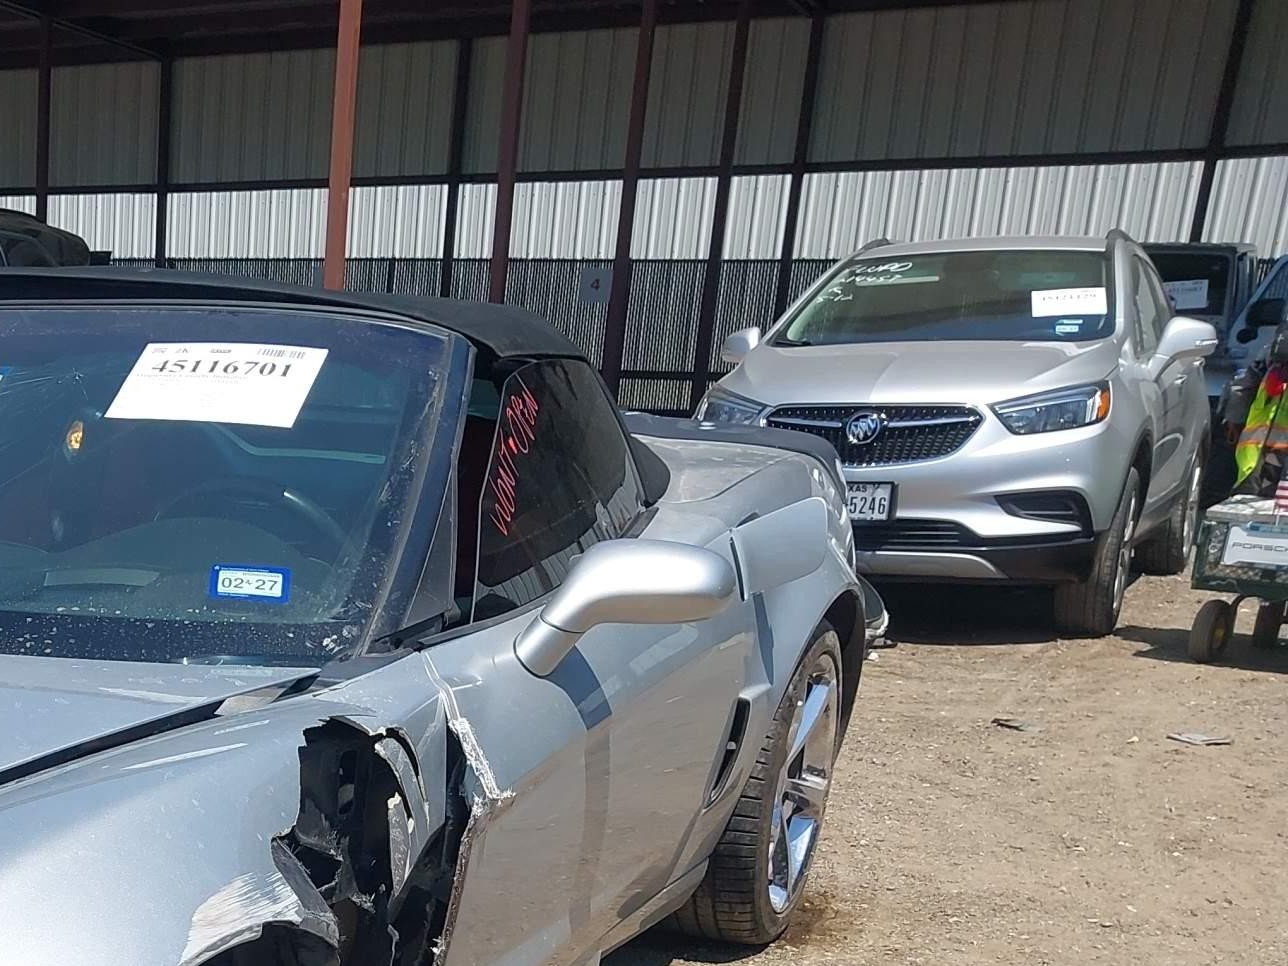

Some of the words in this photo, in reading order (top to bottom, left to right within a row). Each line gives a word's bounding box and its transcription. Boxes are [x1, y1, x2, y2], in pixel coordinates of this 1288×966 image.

[589, 278, 601, 290] 4
[151, 359, 293, 377] 45116701
[848, 484, 868, 493] XAS
[848, 496, 887, 515] 5246
[221, 576, 244, 589] 02
[255, 578, 279, 591] 27
